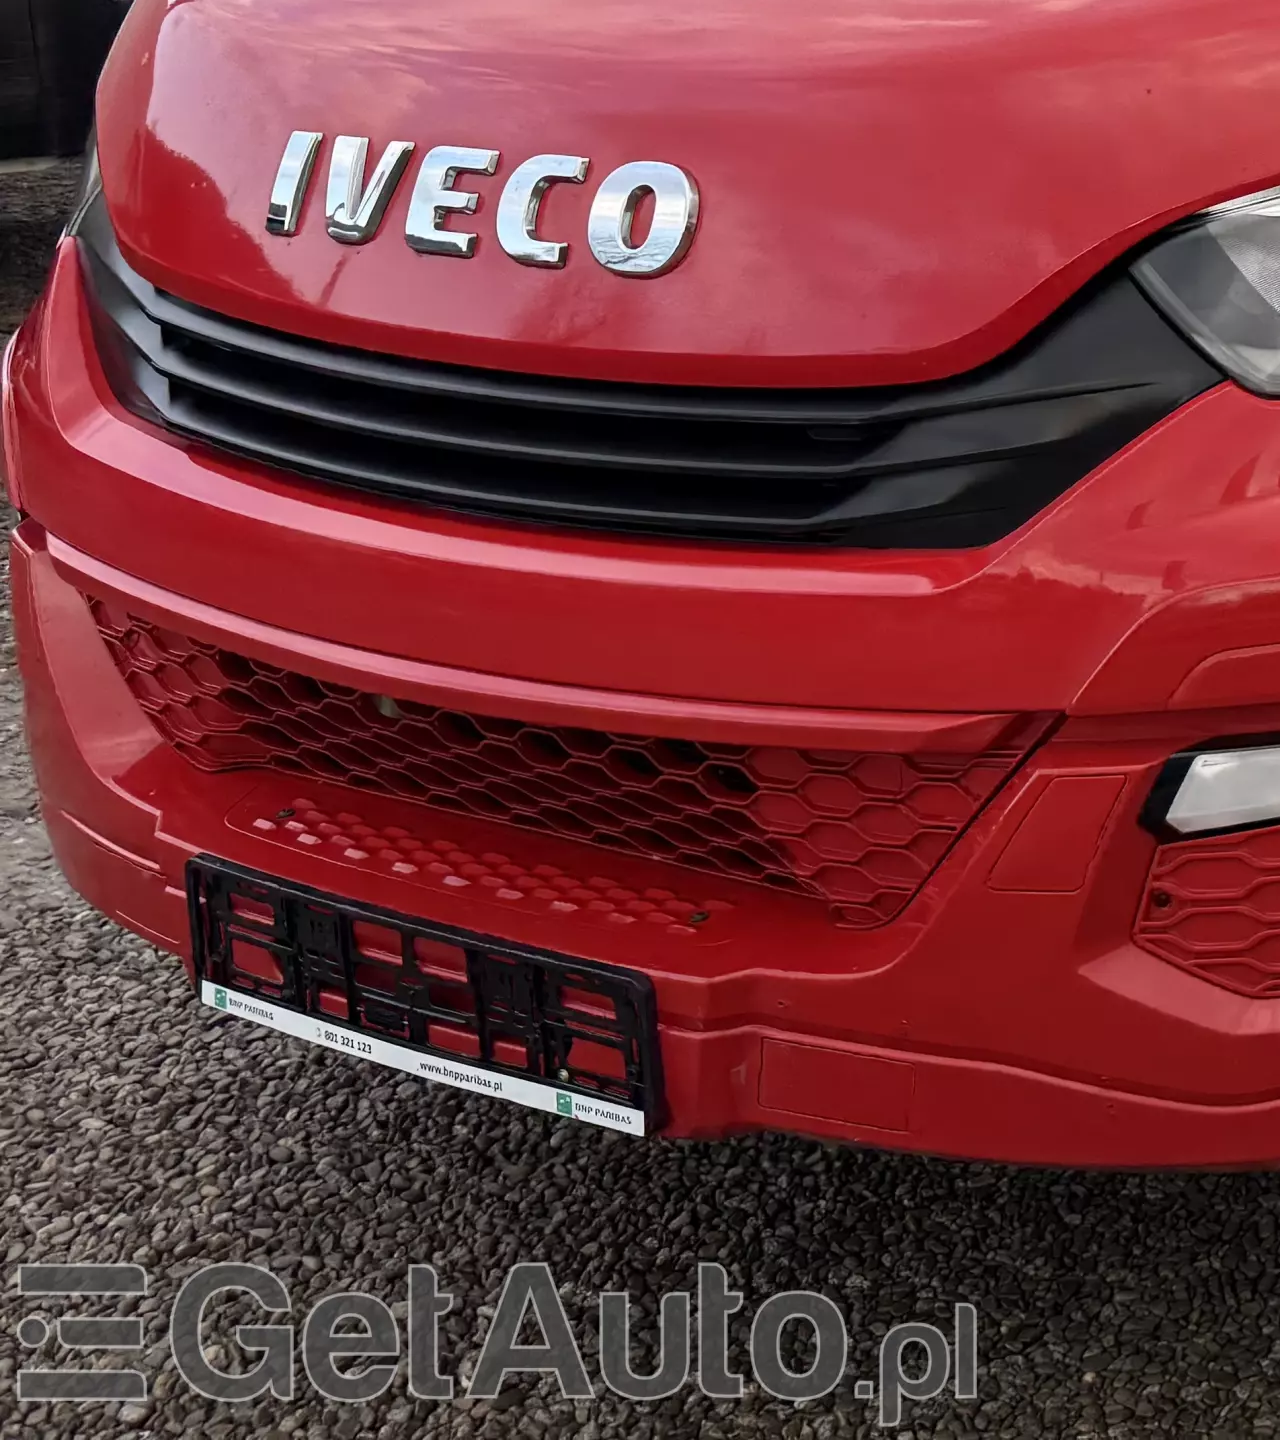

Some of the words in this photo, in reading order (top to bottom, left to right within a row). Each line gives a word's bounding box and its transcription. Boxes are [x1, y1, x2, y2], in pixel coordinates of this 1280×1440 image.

[264, 129, 701, 280] IVECO
[340, 1035, 355, 1049] 321
[357, 1041, 372, 1054] 123
[419, 1061, 503, 1092] www.bnpparibas.pl
[575, 1102, 593, 1114] BNP
[594, 1108, 632, 1125] PARIBAS
